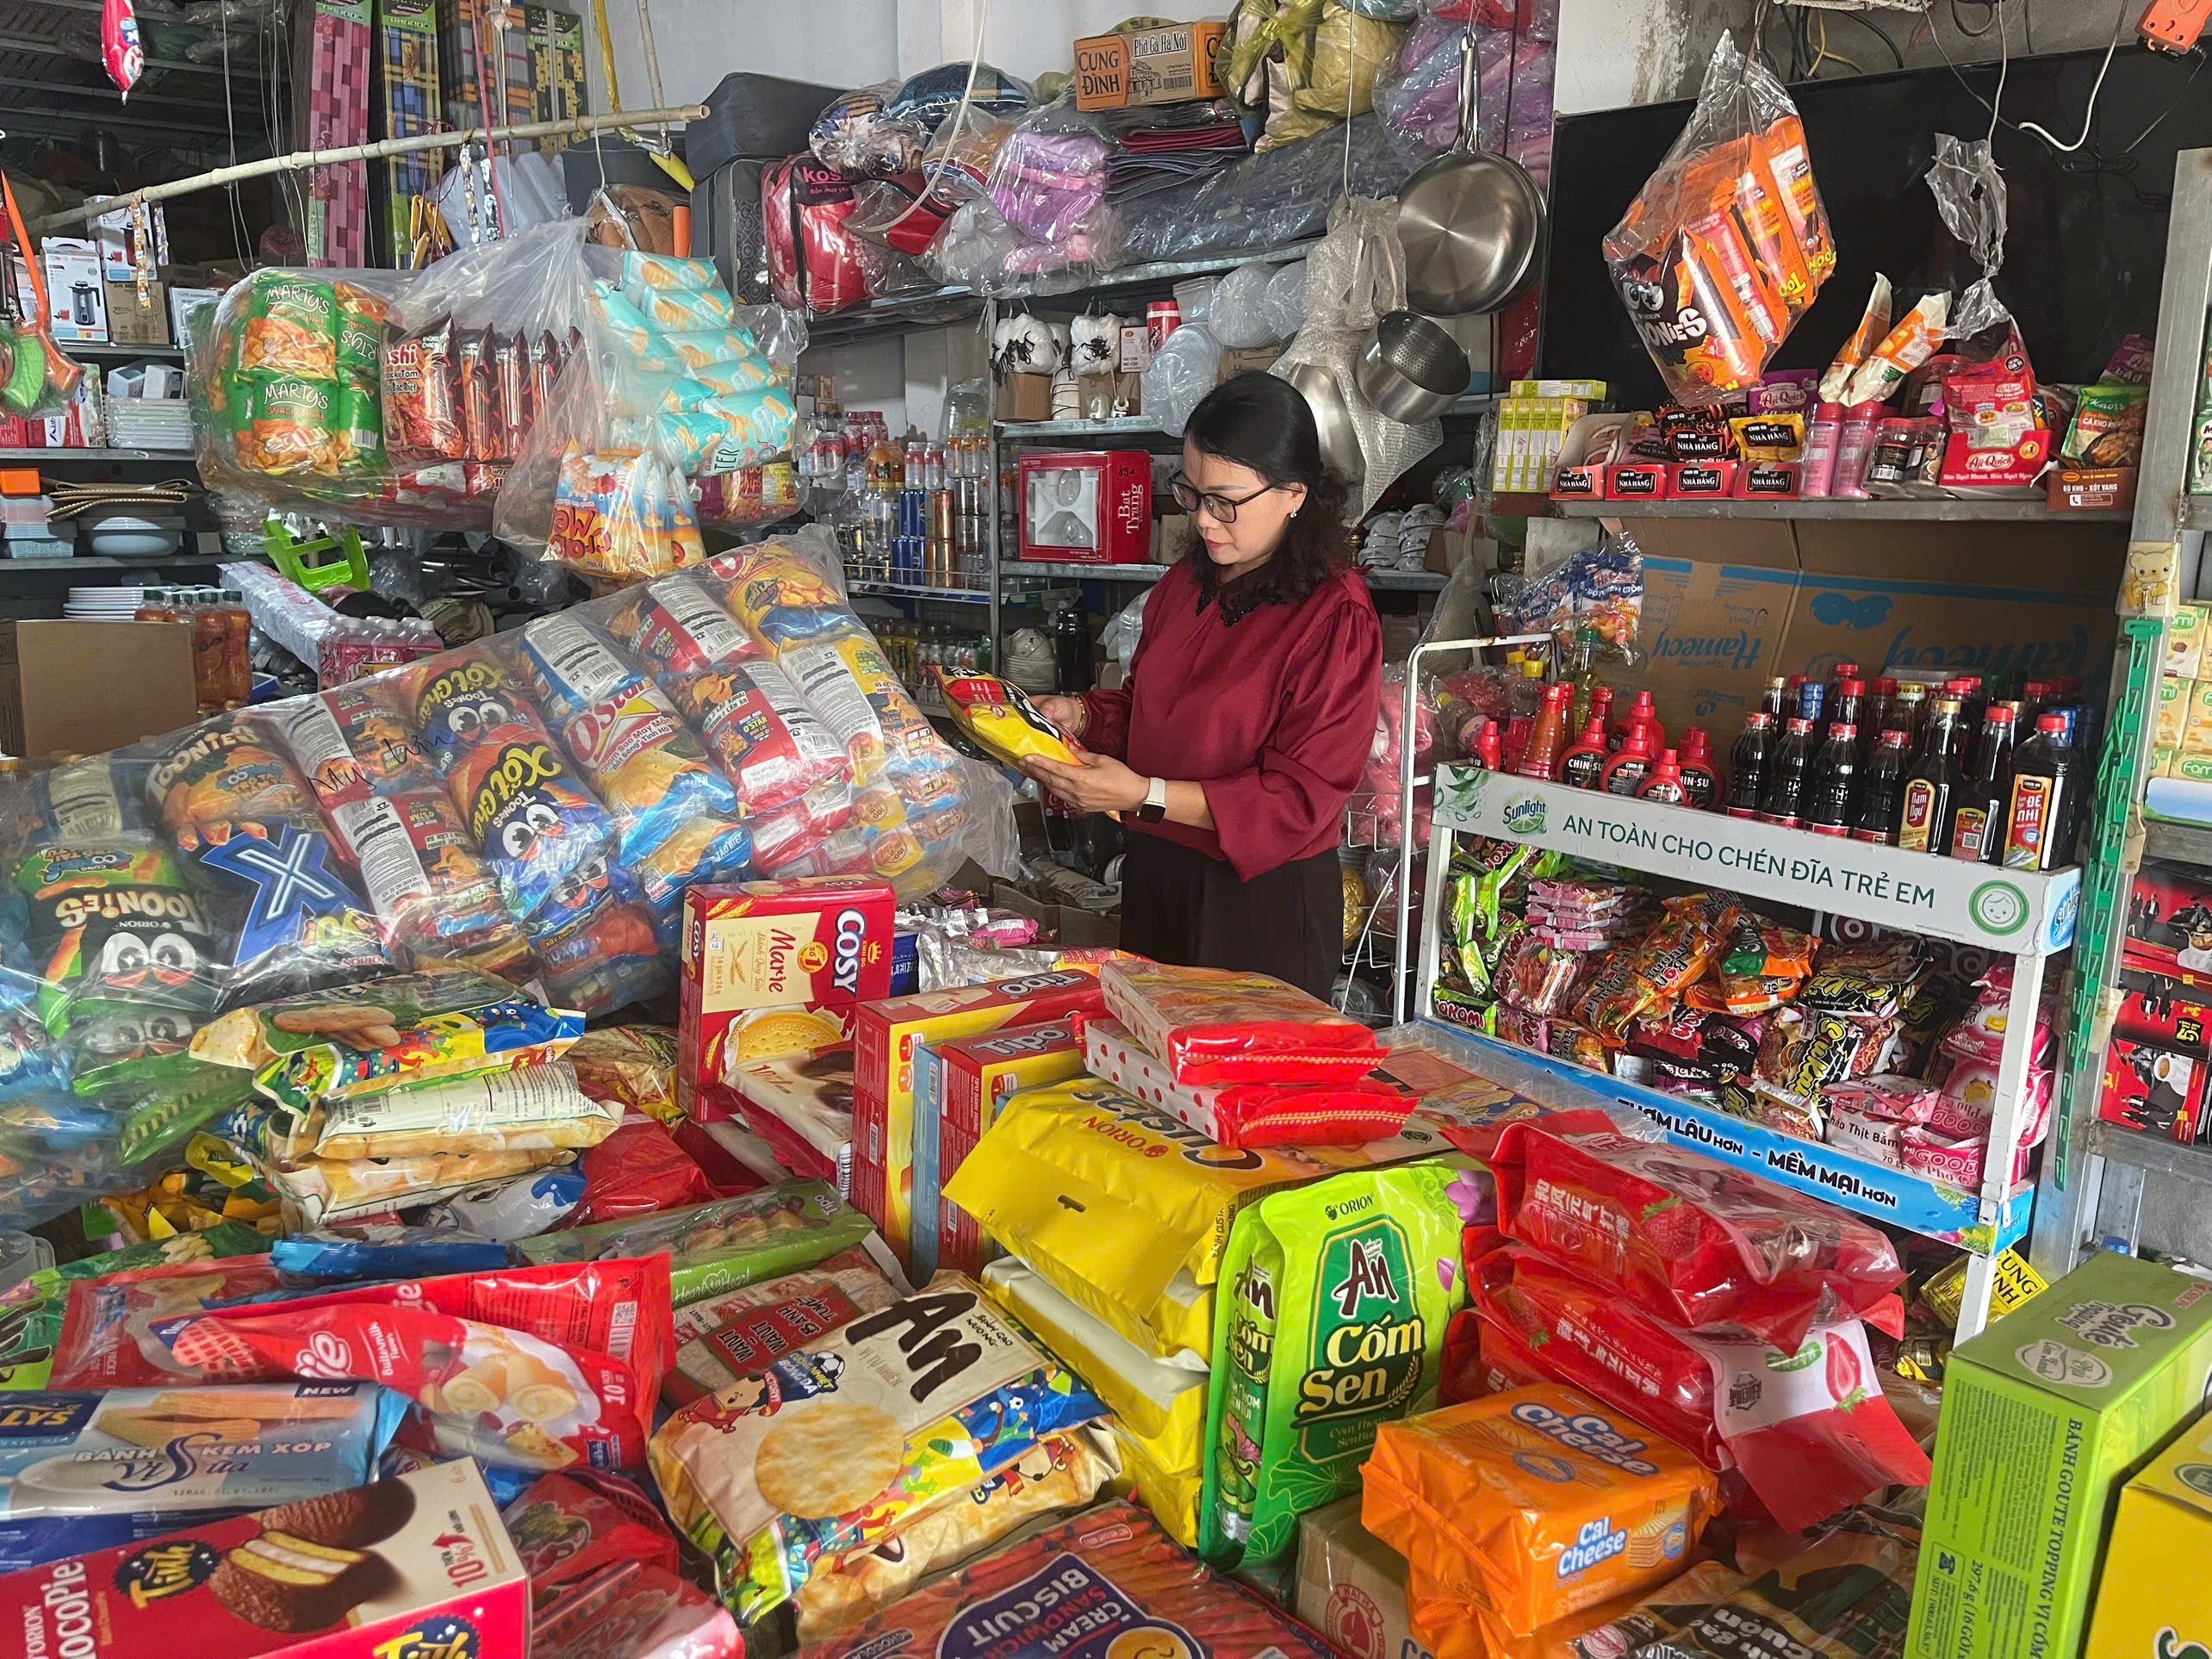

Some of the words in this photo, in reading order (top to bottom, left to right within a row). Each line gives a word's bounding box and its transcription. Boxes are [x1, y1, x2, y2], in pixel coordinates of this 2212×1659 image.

[1161, 34, 1171, 51] Hà
[1078, 51, 1119, 71] CUNG
[1082, 72, 1121, 96] ĐÌNH
[802, 166, 842, 183] kos
[265, 284, 329, 314] MARTY'S
[385, 345, 418, 366] ishi
[264, 382, 329, 409] MARTY'S
[1762, 388, 1807, 407] Aji-Quick
[2089, 397, 2125, 411] Knorr
[1677, 440, 1694, 451] NHÀ
[1695, 439, 1718, 451] HÀNG
[1967, 453, 2015, 471] Aji-Quick
[2072, 484, 2085, 493] KHO
[2101, 483, 2118, 493] VANG
[1680, 775, 1709, 788] HIN-SU
[2183, 762, 2212, 774] fam
[1502, 799, 1546, 824] Sunlight
[1563, 814, 1593, 836] AN
[1598, 821, 1657, 850] TOÀN
[1662, 834, 1713, 861] CHO
[1718, 845, 1786, 877] CHÉN
[1791, 859, 1834, 888] ĐĨA
[1840, 869, 1891, 899] TRẺ
[1895, 881, 1936, 909] EM
[768, 928, 797, 994] Marie
[833, 909, 866, 998] COSY
[997, 973, 1086, 995] Tipo
[1437, 999, 1486, 1028] OKOMI
[970, 1029, 1071, 1055] Tipo
[1084, 1115, 1148, 1150] ORION
[1849, 1122, 1869, 1140] Thịt
[1674, 1119, 1713, 1144] LÂU
[1712, 1135, 1743, 1155] HƠN
[1768, 1148, 1817, 1181] MỀM
[1819, 1167, 1860, 1196] MẠI
[1861, 1187, 1897, 1208] HƠN
[1339, 1196, 1375, 1217] ORION
[674, 1281, 706, 1304] Heart
[722, 1266, 752, 1292] Heart
[1332, 1238, 1399, 1320] An
[368, 1321, 394, 1377] Buttermilk
[717, 1329, 757, 1364] WANT
[749, 1320, 790, 1354] WANT
[1326, 1315, 1423, 1369] Cốm
[301, 1386, 353, 1396] NEW
[1299, 1367, 1388, 1414] Sen
[1511, 1401, 1660, 1477] Cheese
[1568, 1413, 1649, 1455] Cal
[2062, 1418, 2083, 1468] BÁNH
[199, 1442, 262, 1457] KEM
[1578, 1515, 1611, 1546] Cal
[447, 1542, 488, 1588] 10%
[1556, 1528, 1627, 1578] Cheese
[2040, 1529, 2064, 1600] TOPPING
[966, 1567, 1090, 1646] BISCUIT
[1043, 1601, 1124, 1653] CREAM
